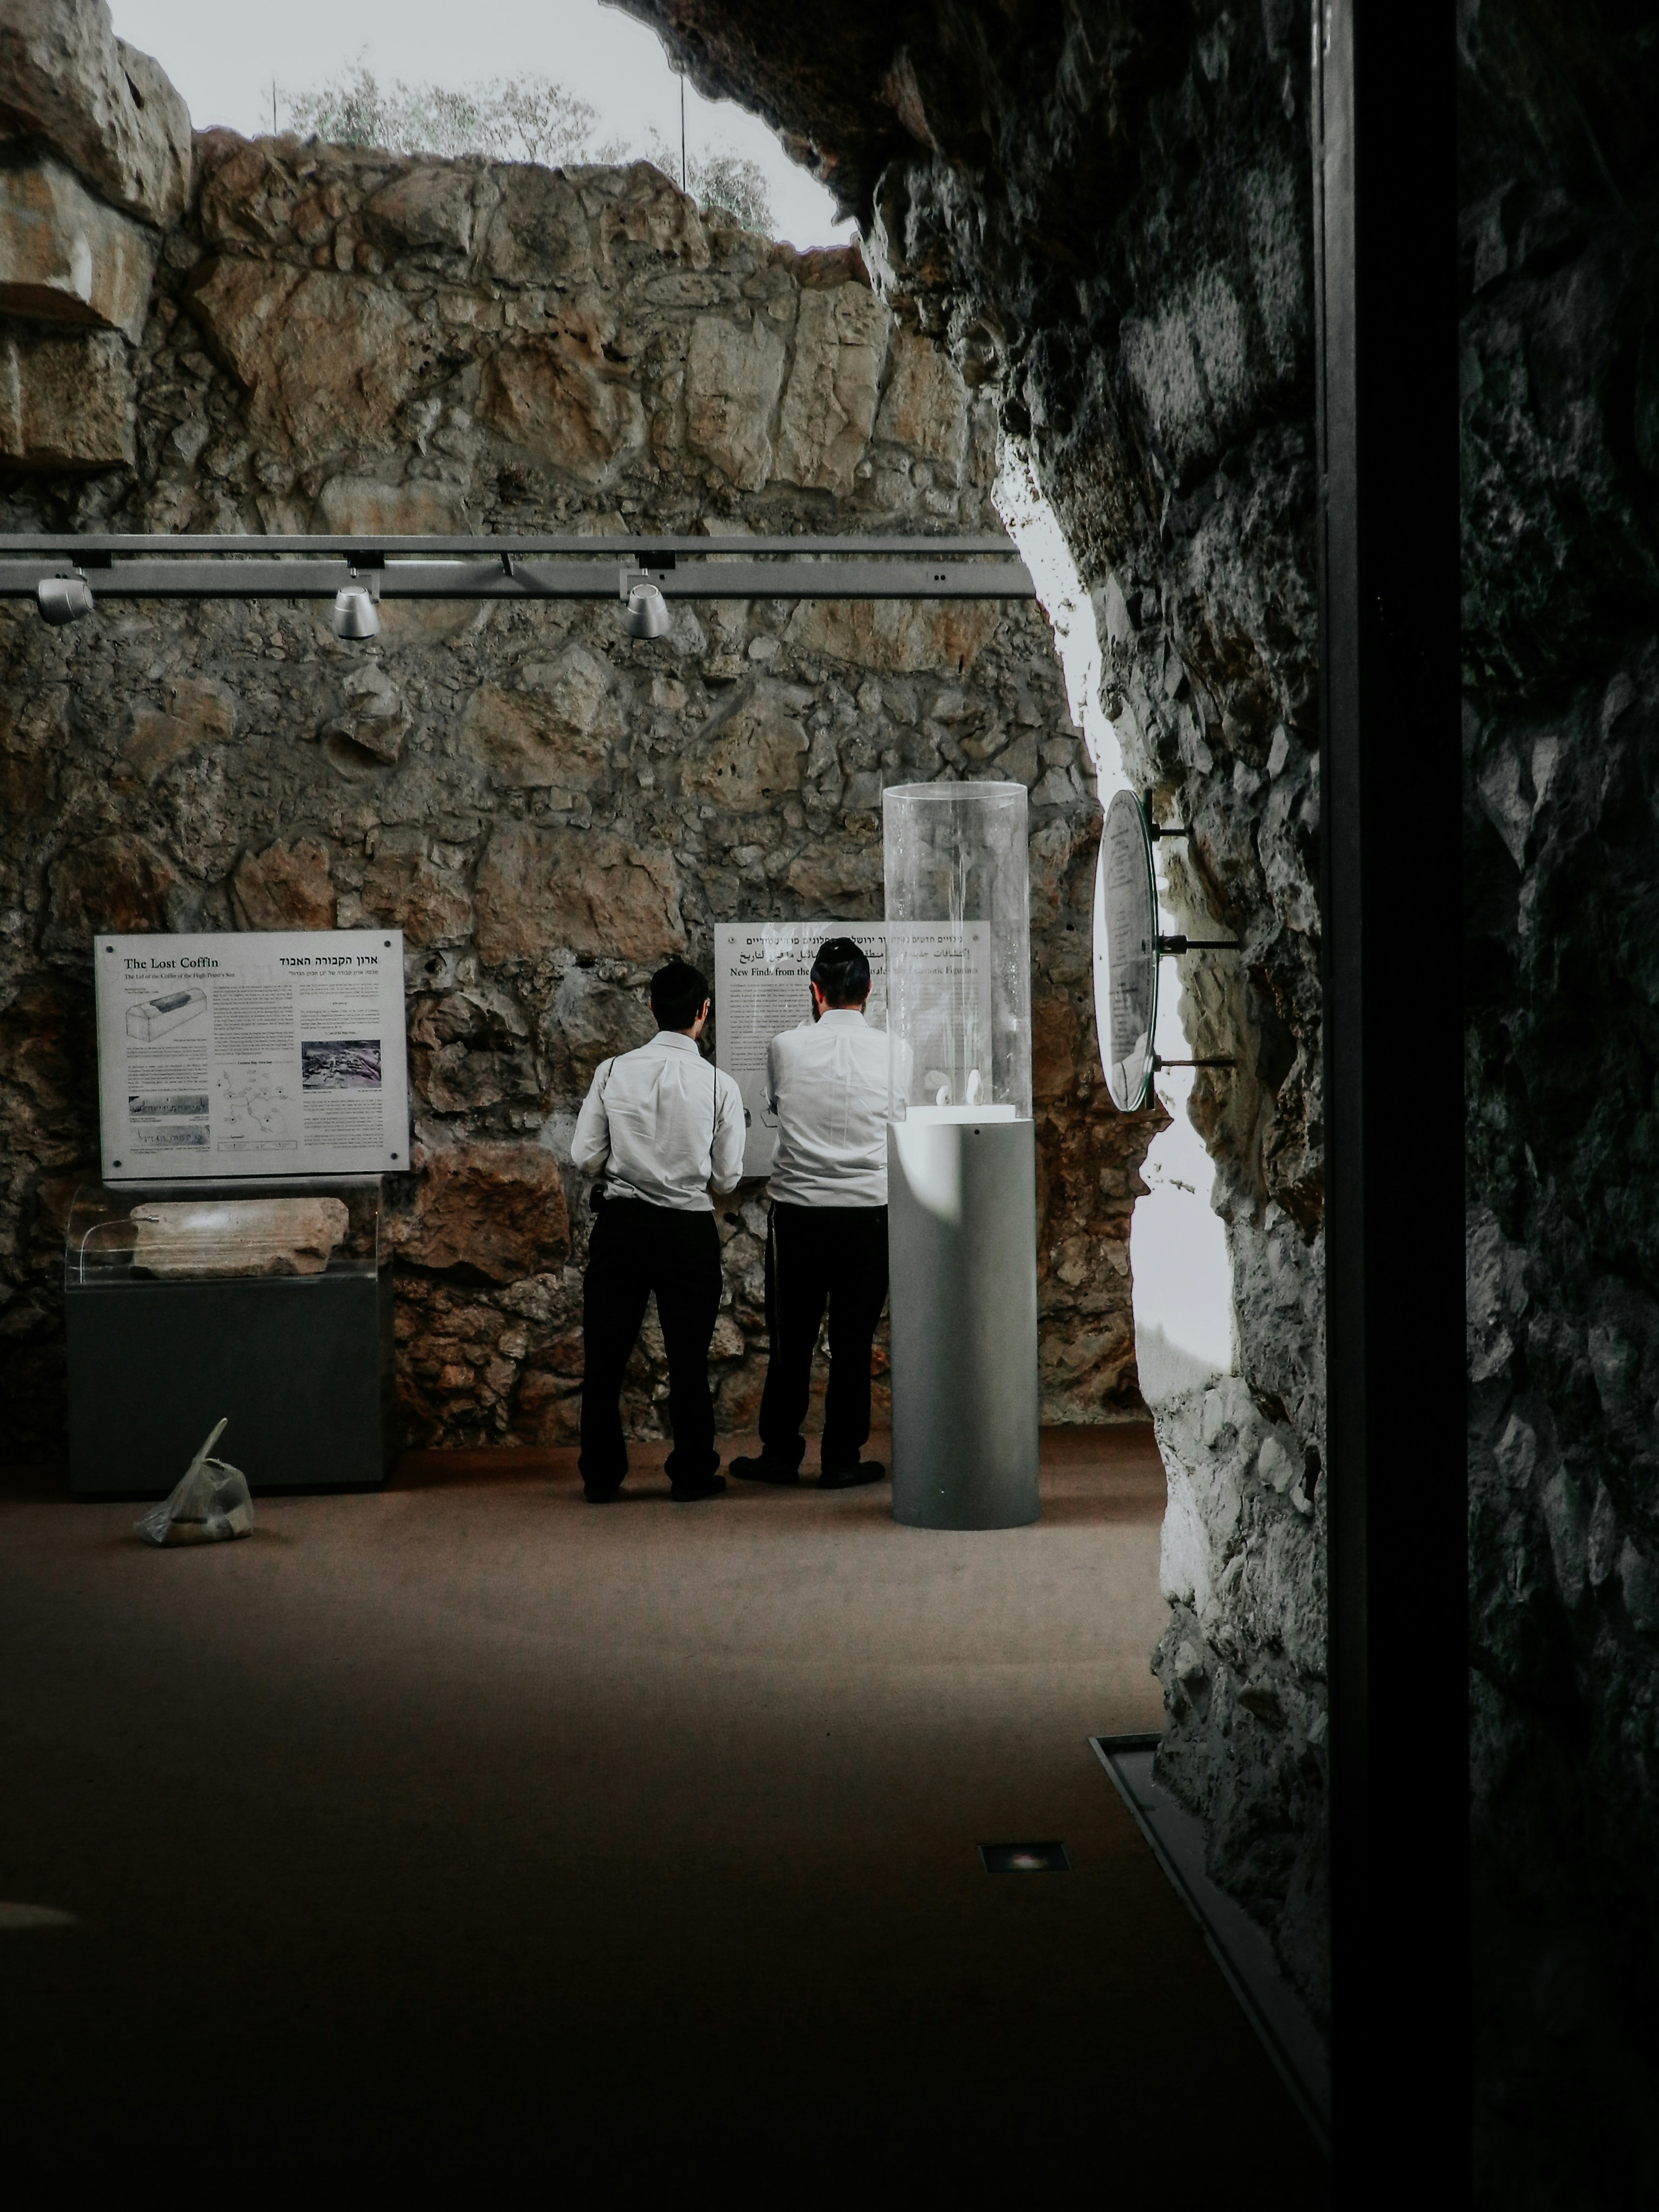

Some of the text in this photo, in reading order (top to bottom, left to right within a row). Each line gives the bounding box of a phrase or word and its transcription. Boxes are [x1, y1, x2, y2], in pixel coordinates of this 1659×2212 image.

[803, 936, 832, 944] סלונים
[851, 935, 874, 944] ירושל
[124, 957, 219, 969] The Lost Coffin
[279, 956, 378, 966] ארון הקבורה האבוד
[730, 967, 748, 976] New
[775, 967, 795, 976] from
[797, 967, 810, 975] the
